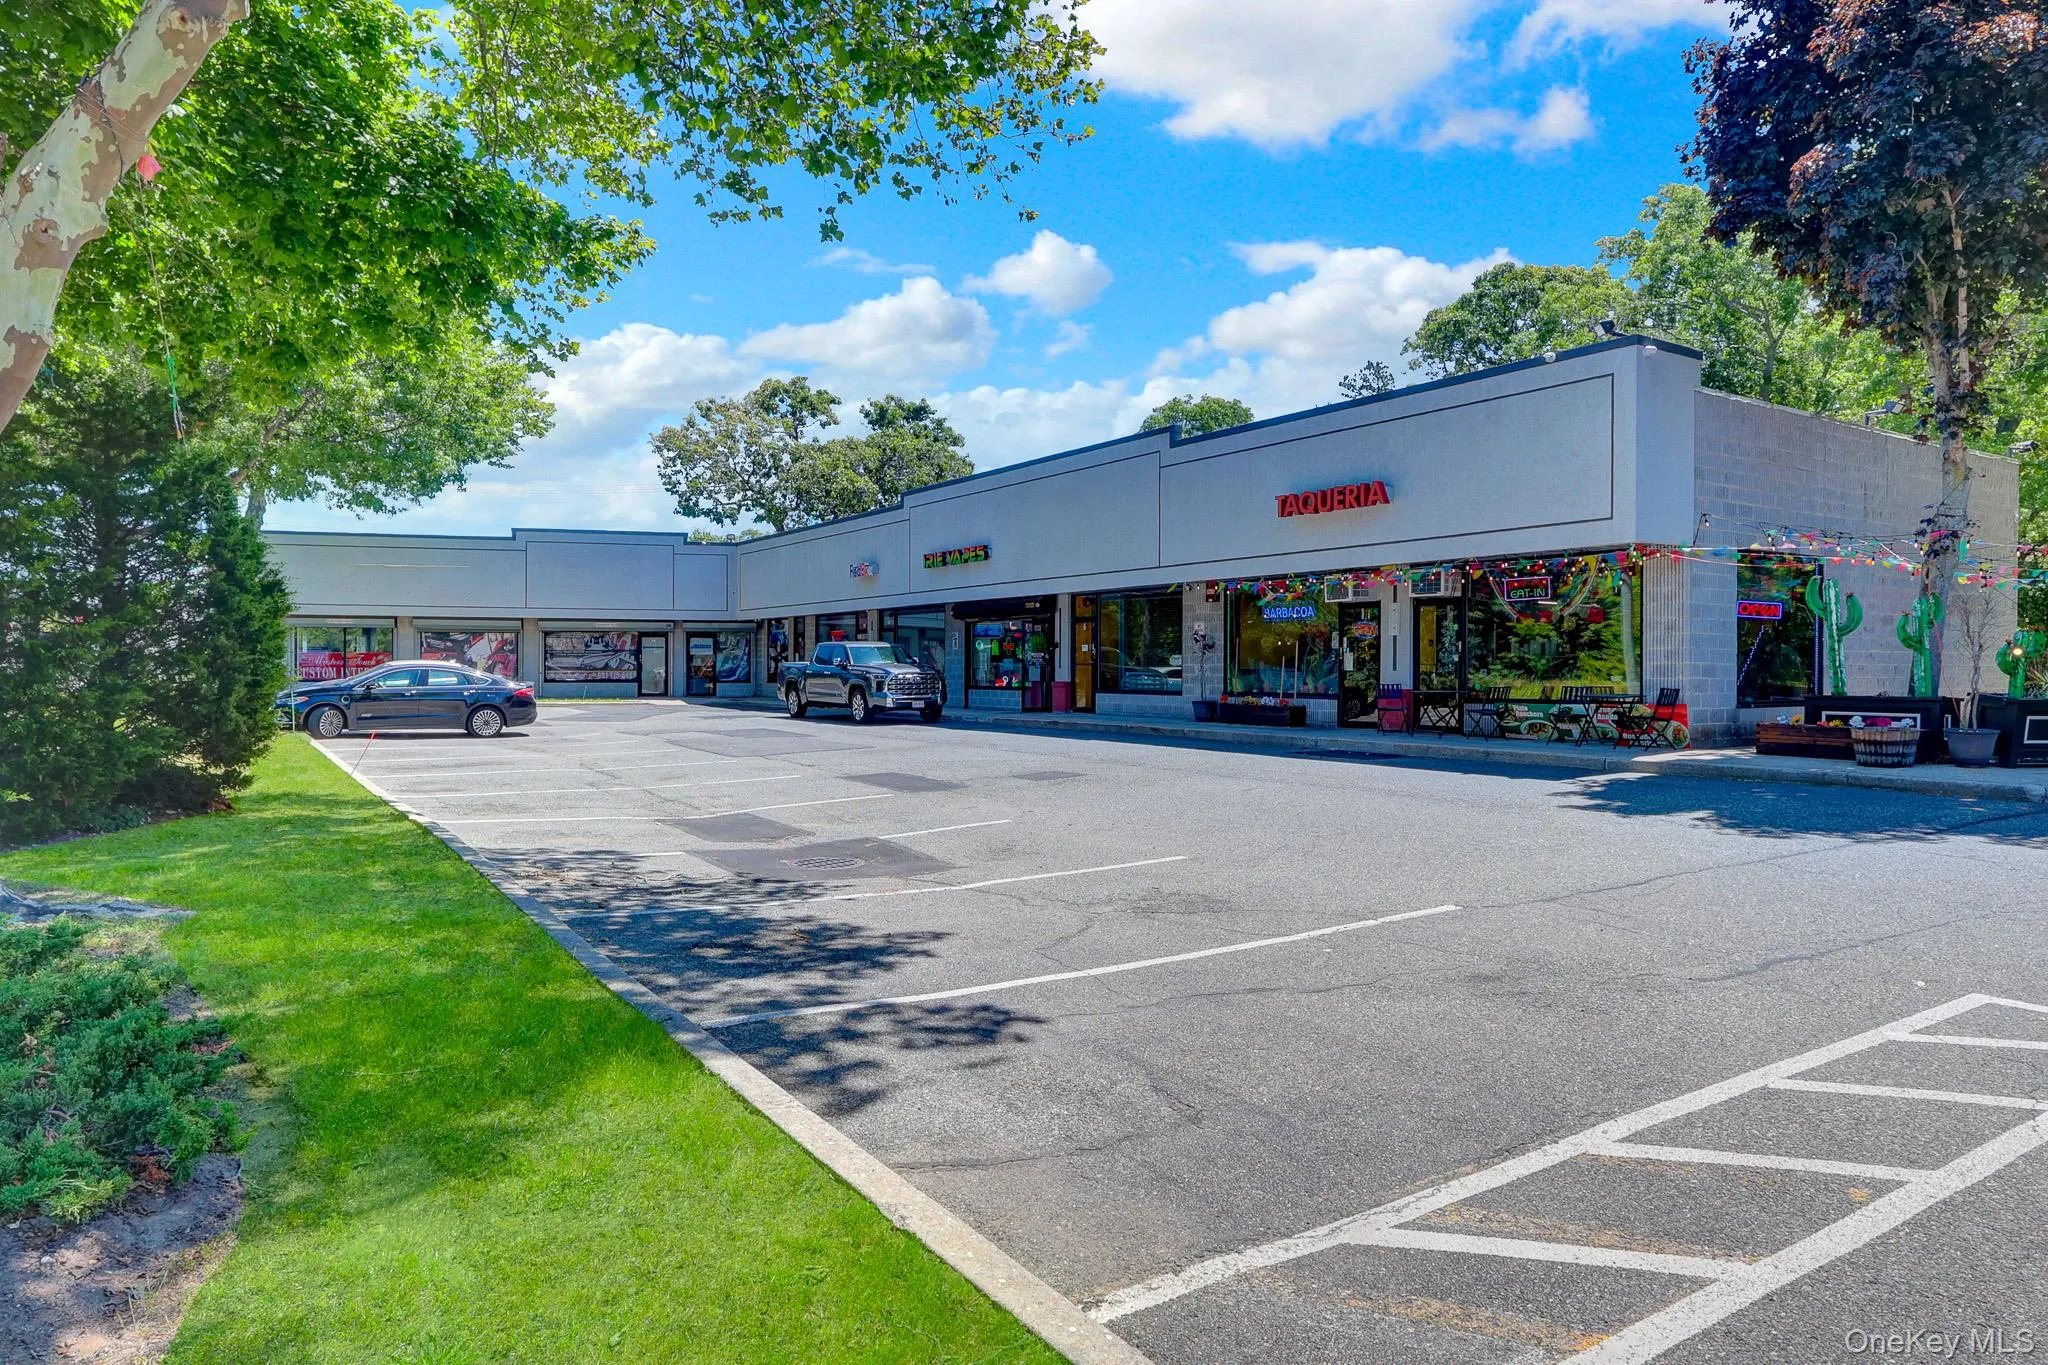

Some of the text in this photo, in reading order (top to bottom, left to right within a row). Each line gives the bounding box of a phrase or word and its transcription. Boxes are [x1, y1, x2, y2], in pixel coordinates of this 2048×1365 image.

[1275, 481, 1390, 518] TAQUERIA
[923, 545, 989, 569] IRIE VAPES
[1263, 605, 1315, 619] BARBACOA
[1739, 603, 1780, 617] OPEN
